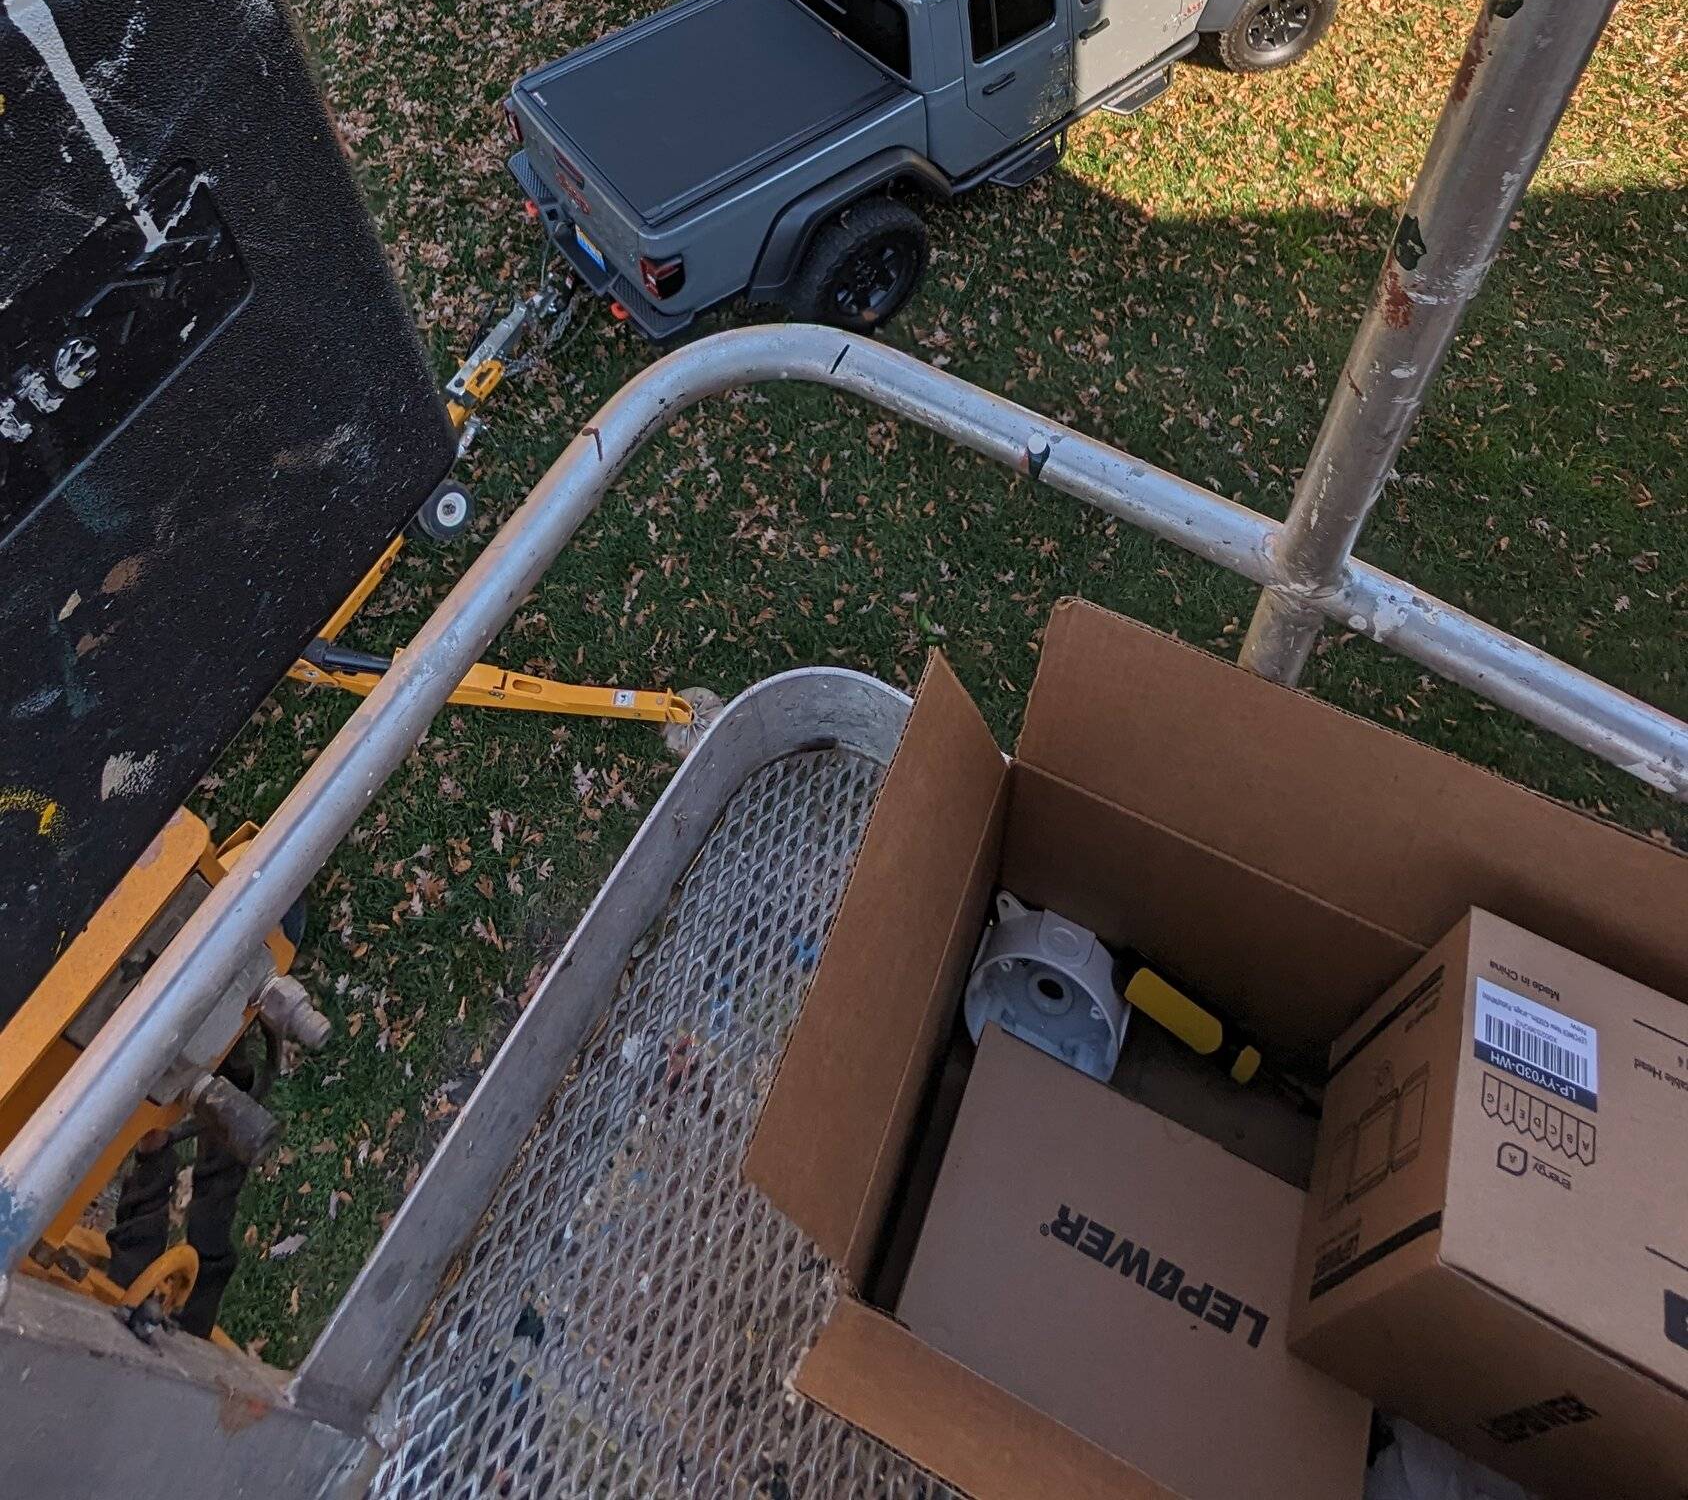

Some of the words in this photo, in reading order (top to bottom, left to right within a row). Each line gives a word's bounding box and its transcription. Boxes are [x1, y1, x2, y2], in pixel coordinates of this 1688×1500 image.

[1490, 959, 1518, 981] China
[1521, 975, 1531, 987] in
[1532, 980, 1560, 1001] Made
[1490, 1050, 1576, 1100] LP-YY03D-WH
[1633, 1058, 1662, 1081] Head
[1486, 1092, 1494, 1103] G
[1503, 1101, 1510, 1112] F
[1519, 1109, 1526, 1119] E
[1533, 1117, 1541, 1128] D
[1550, 1124, 1557, 1135] C
[1566, 1133, 1573, 1144] B
[1582, 1140, 1590, 1151] A
[1508, 1152, 1517, 1163] A
[1532, 1161, 1571, 1190] Energy
